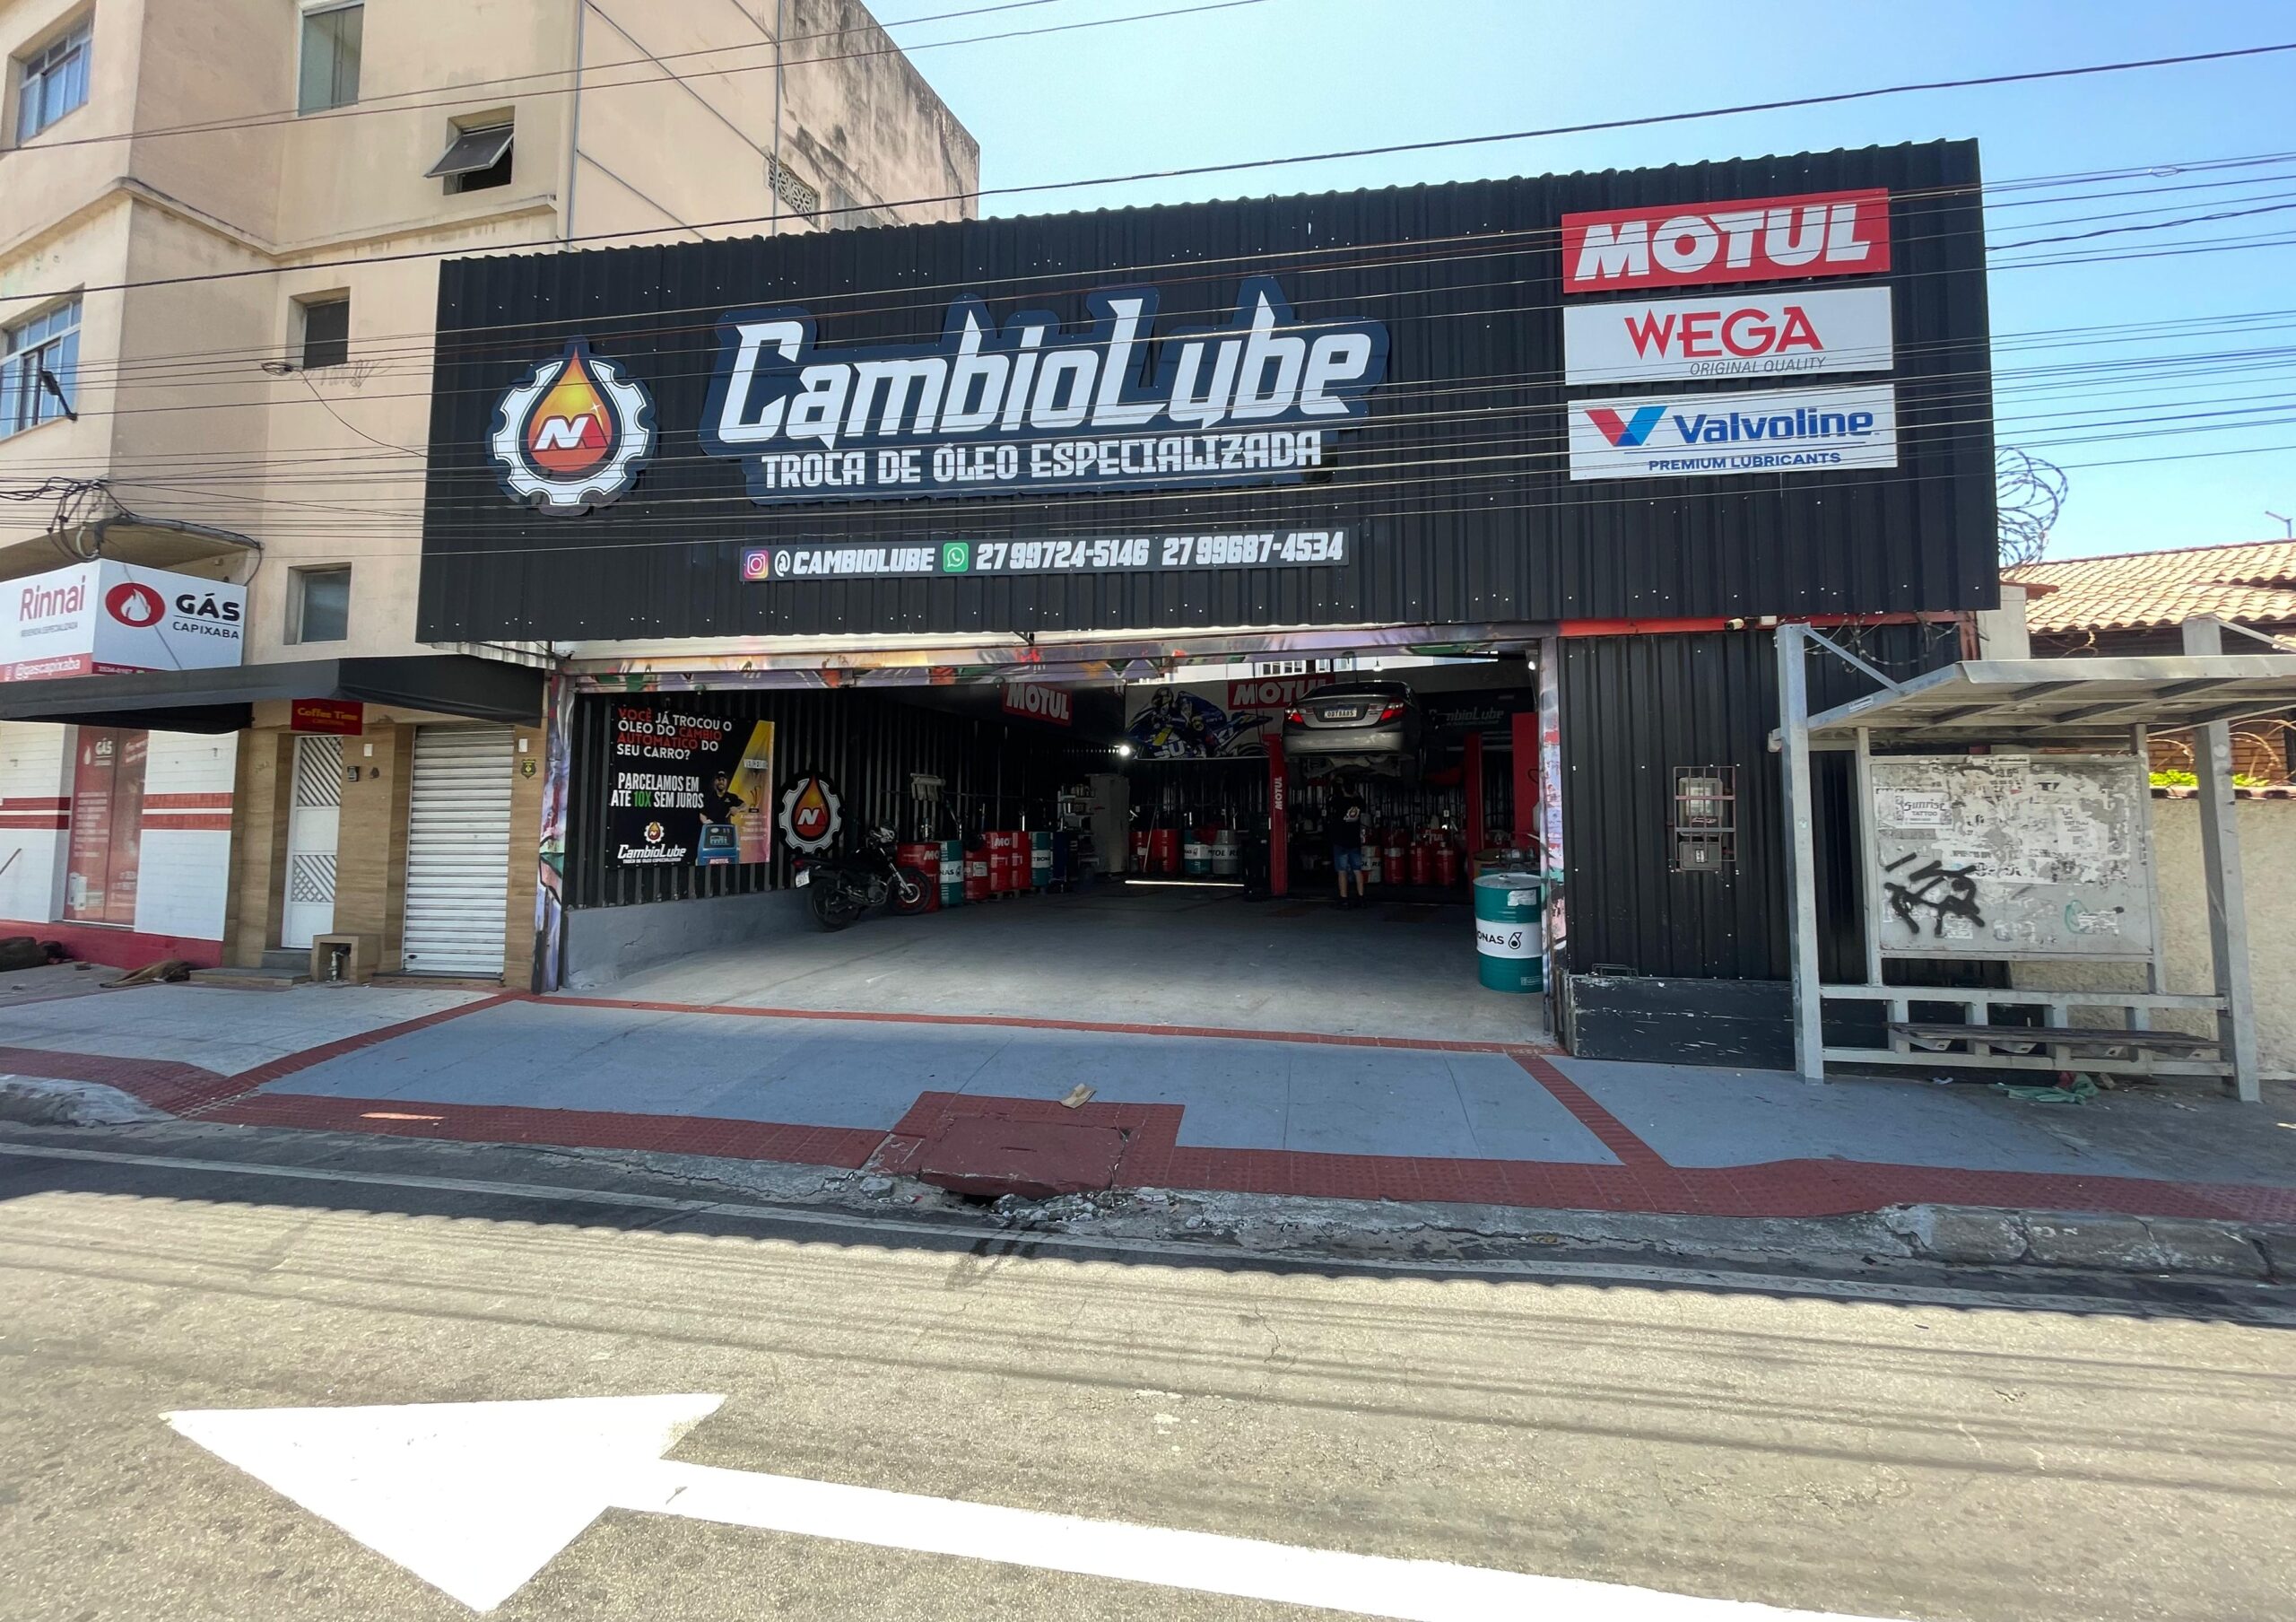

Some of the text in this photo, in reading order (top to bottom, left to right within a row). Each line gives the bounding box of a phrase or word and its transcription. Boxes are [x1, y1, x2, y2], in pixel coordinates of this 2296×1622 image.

[1574, 204, 1871, 281] MOTUL
[1624, 306, 1824, 360] WEGA
[718, 290, 1371, 450] CambioLube
[1690, 356, 1826, 376] ORIGINAL QUALITY
[1673, 407, 1873, 443] Valvoline
[761, 431, 1322, 489] TROCA DE ÓLEO ESPECIALIZADA
[1648, 452, 1842, 471] PREMIUM LUBRICANTS
[976, 539, 1150, 571] 27 99724-5146
[1161, 531, 1344, 566] 27 99687-4534
[19, 575, 86, 622] Rinnai
[175, 592, 240, 622] GÁS
[172, 621, 239, 640] CAPIXABA
[1006, 683, 1070, 720] MOTUL
[297, 707, 358, 721] Coffee Time
[655, 711, 670, 725] JÁ
[673, 714, 720, 730] TROCOU
[723, 720, 733, 732] O
[618, 717, 654, 734] ÓLEO
[657, 724, 676, 737] DO
[616, 743, 691, 761] SEU CARRO?
[701, 739, 719, 752] DO
[618, 772, 700, 792] PARCELAMOS EM
[633, 790, 652, 807] 10X
[653, 790, 674, 808] SEM
[675, 791, 704, 809] JUROS
[1274, 776, 1283, 811] MOTUL
[1903, 798, 1946, 812] Sunrise
[617, 843, 687, 860] CambioLube
